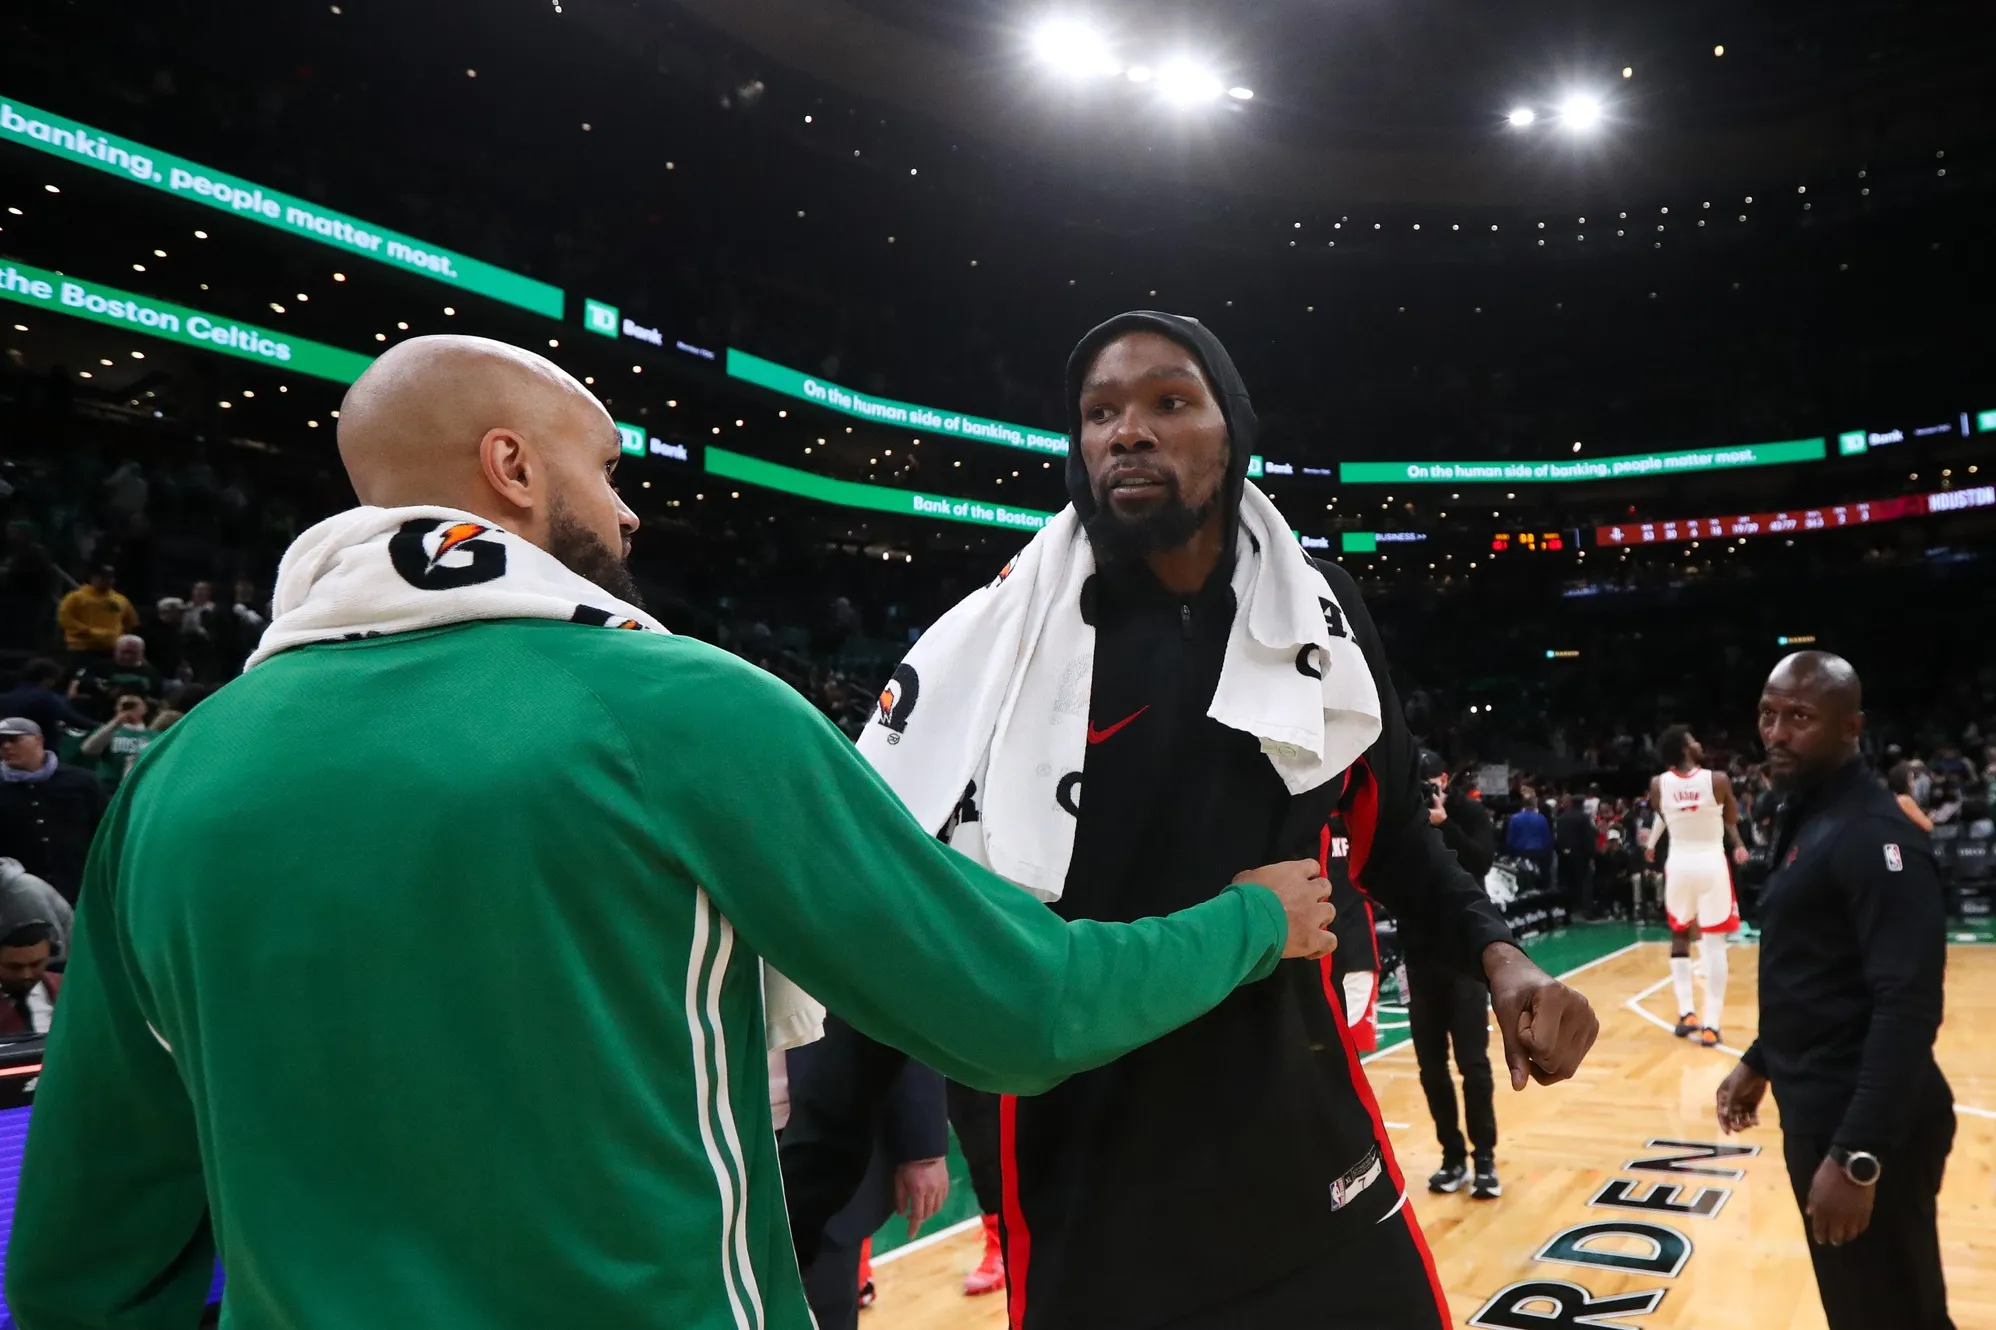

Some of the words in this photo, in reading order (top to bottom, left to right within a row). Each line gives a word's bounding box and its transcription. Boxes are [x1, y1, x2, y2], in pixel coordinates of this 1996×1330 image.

[1, 104, 162, 183] banking,
[170, 167, 281, 219] people
[287, 207, 381, 253] matter
[388, 240, 458, 277] most.
[60, 281, 180, 332] Boston
[186, 317, 291, 361] Celtics
[586, 306, 616, 332] TD
[623, 319, 663, 346] Bank
[804, 379, 826, 401] On
[827, 388, 851, 409] the
[853, 396, 907, 423] human
[910, 408, 942, 428] side
[944, 415, 961, 431] of
[962, 416, 1025, 446] banking,
[649, 438, 688, 461] Bank
[1868, 429, 1904, 446] Bank
[1265, 461, 1294, 476] Bank
[1408, 465, 1429, 478] On
[1431, 465, 1454, 478] the
[1456, 463, 1502, 478] human
[1504, 462, 1533, 477] side
[1534, 461, 1548, 476] of
[1550, 459, 1610, 479] banking,
[1613, 456, 1662, 475] people
[1663, 453, 1712, 469] matter
[1715, 450, 1757, 465] most.
[913, 496, 949, 515] Bank
[952, 502, 968, 517] of
[970, 504, 994, 520] the
[996, 507, 1042, 527] Boston
[1928, 487, 1996, 512] HOUSTON
[1301, 536, 1329, 549] Bank
